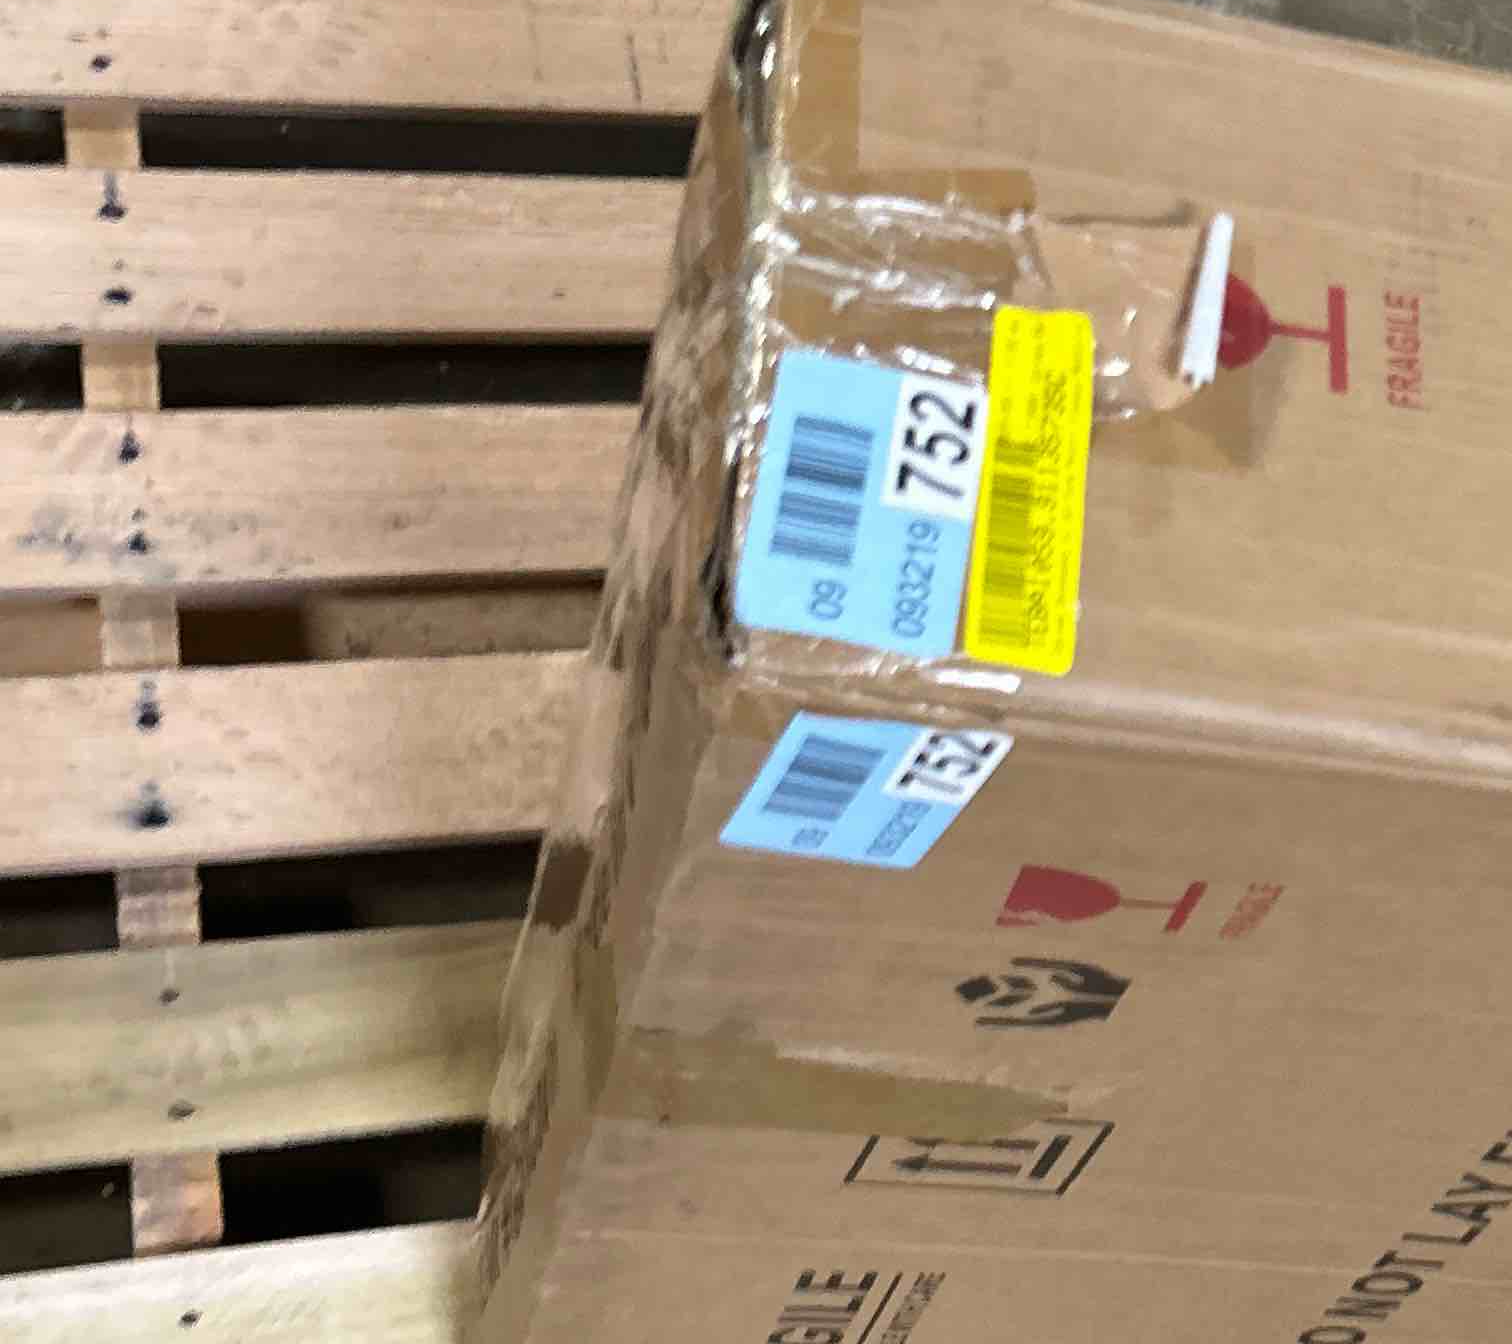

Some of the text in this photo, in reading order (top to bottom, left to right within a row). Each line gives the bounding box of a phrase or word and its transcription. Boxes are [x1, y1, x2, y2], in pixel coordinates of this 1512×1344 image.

[1384, 290, 1425, 412] FRAGILE
[896, 390, 976, 500] 752
[805, 577, 848, 621] 09
[891, 518, 941, 640] 093219
[897, 734, 999, 796] 752
[1323, 1249, 1445, 1320] NOT
